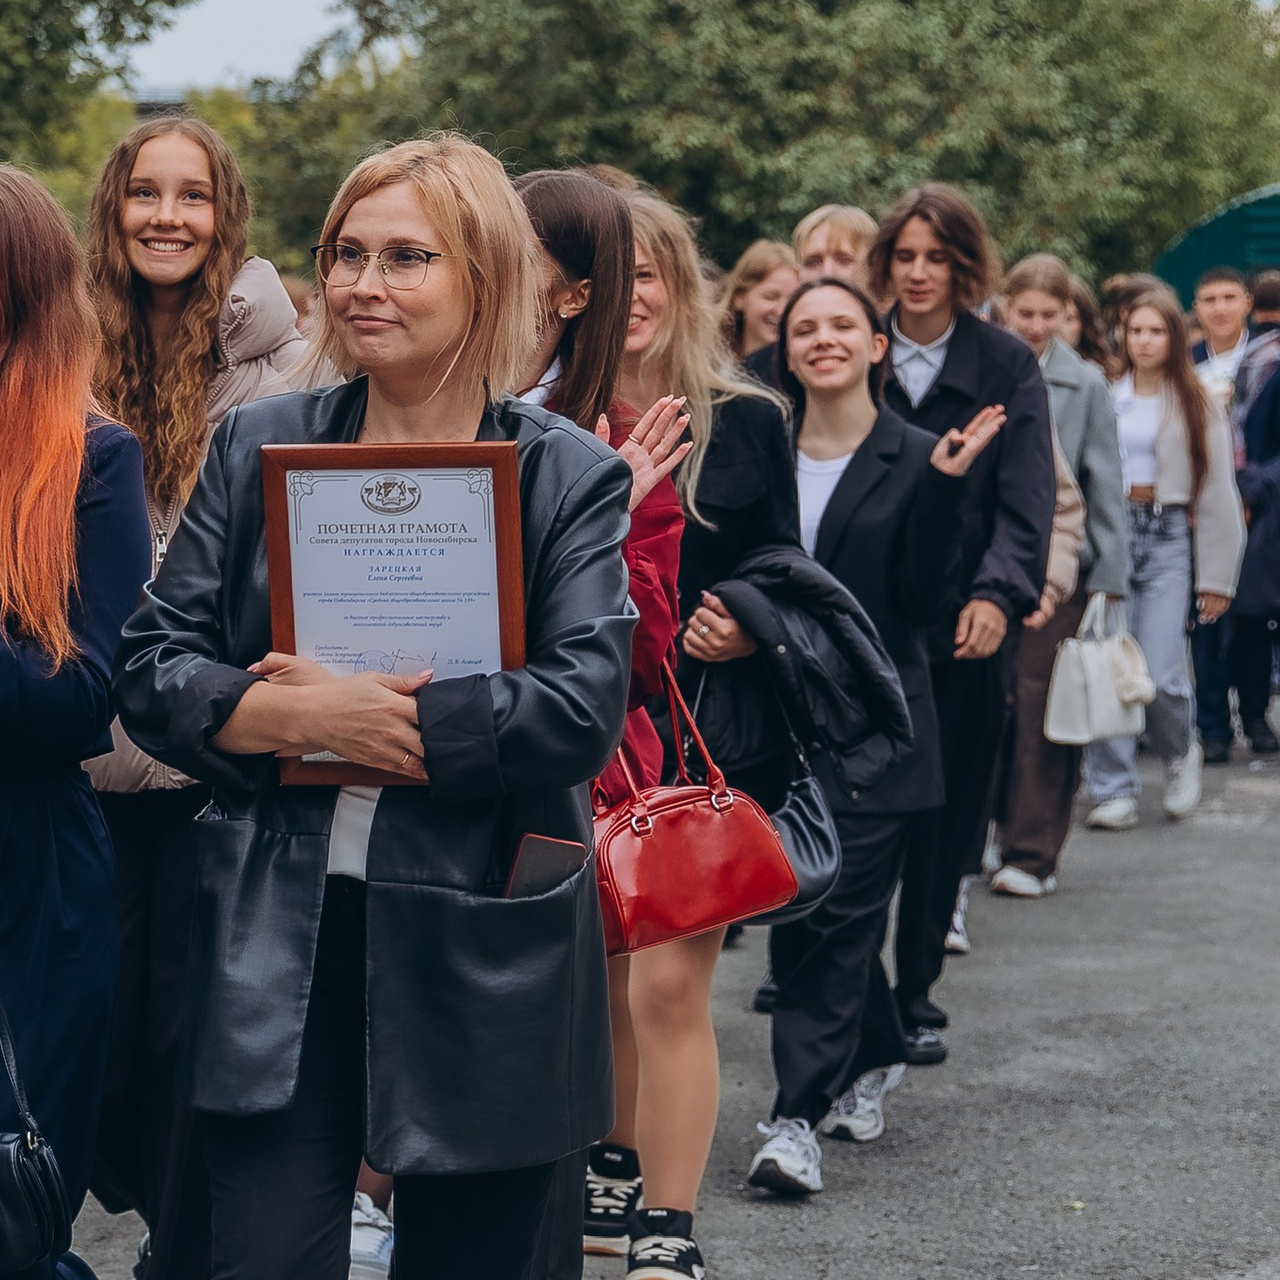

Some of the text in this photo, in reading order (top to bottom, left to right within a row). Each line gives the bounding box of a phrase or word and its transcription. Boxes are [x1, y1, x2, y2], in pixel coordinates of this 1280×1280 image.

[317, 522, 468, 535] ПОЧЕТНАЯ ГРАМОТА
[309, 535, 478, 546] Совета депутатов города Новосибирска
[343, 548, 445, 557] НАГРАЖДАЕТСЯ
[369, 565, 422, 573] ЗАРЕЦКАЯ
